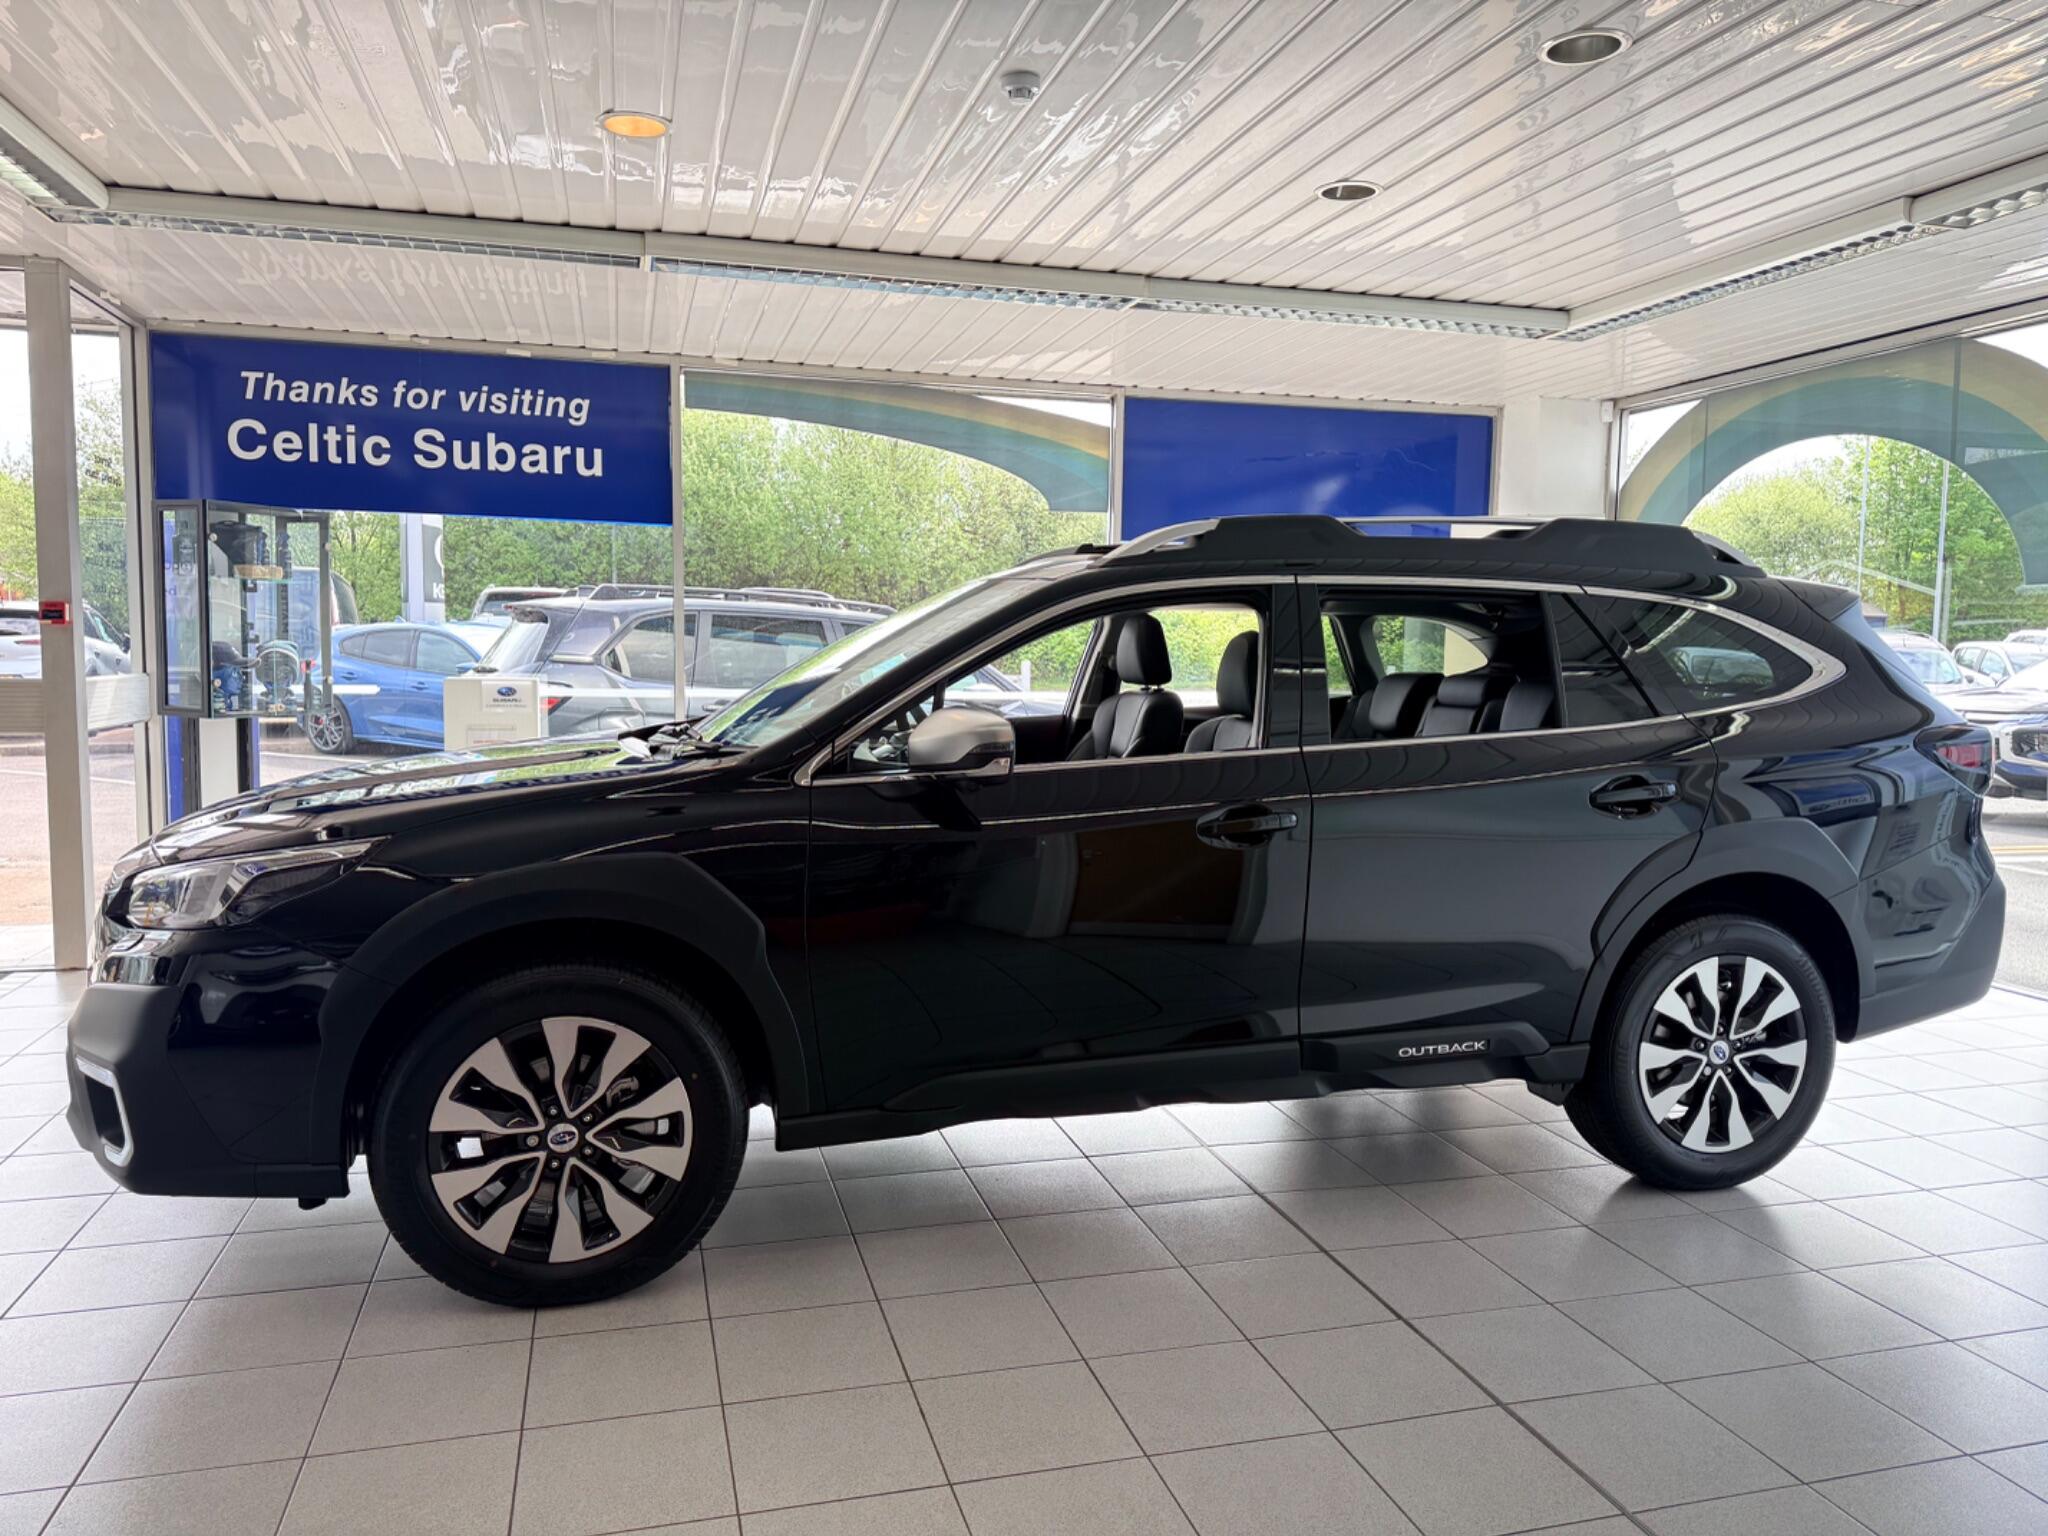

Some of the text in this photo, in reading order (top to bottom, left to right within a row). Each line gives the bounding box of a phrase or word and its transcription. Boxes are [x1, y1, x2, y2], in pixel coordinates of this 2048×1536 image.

[240, 370, 591, 425] Thanks for visiting
[227, 418, 604, 477] Celtic Subaru
[1398, 1041, 1486, 1057] OUTBACK
